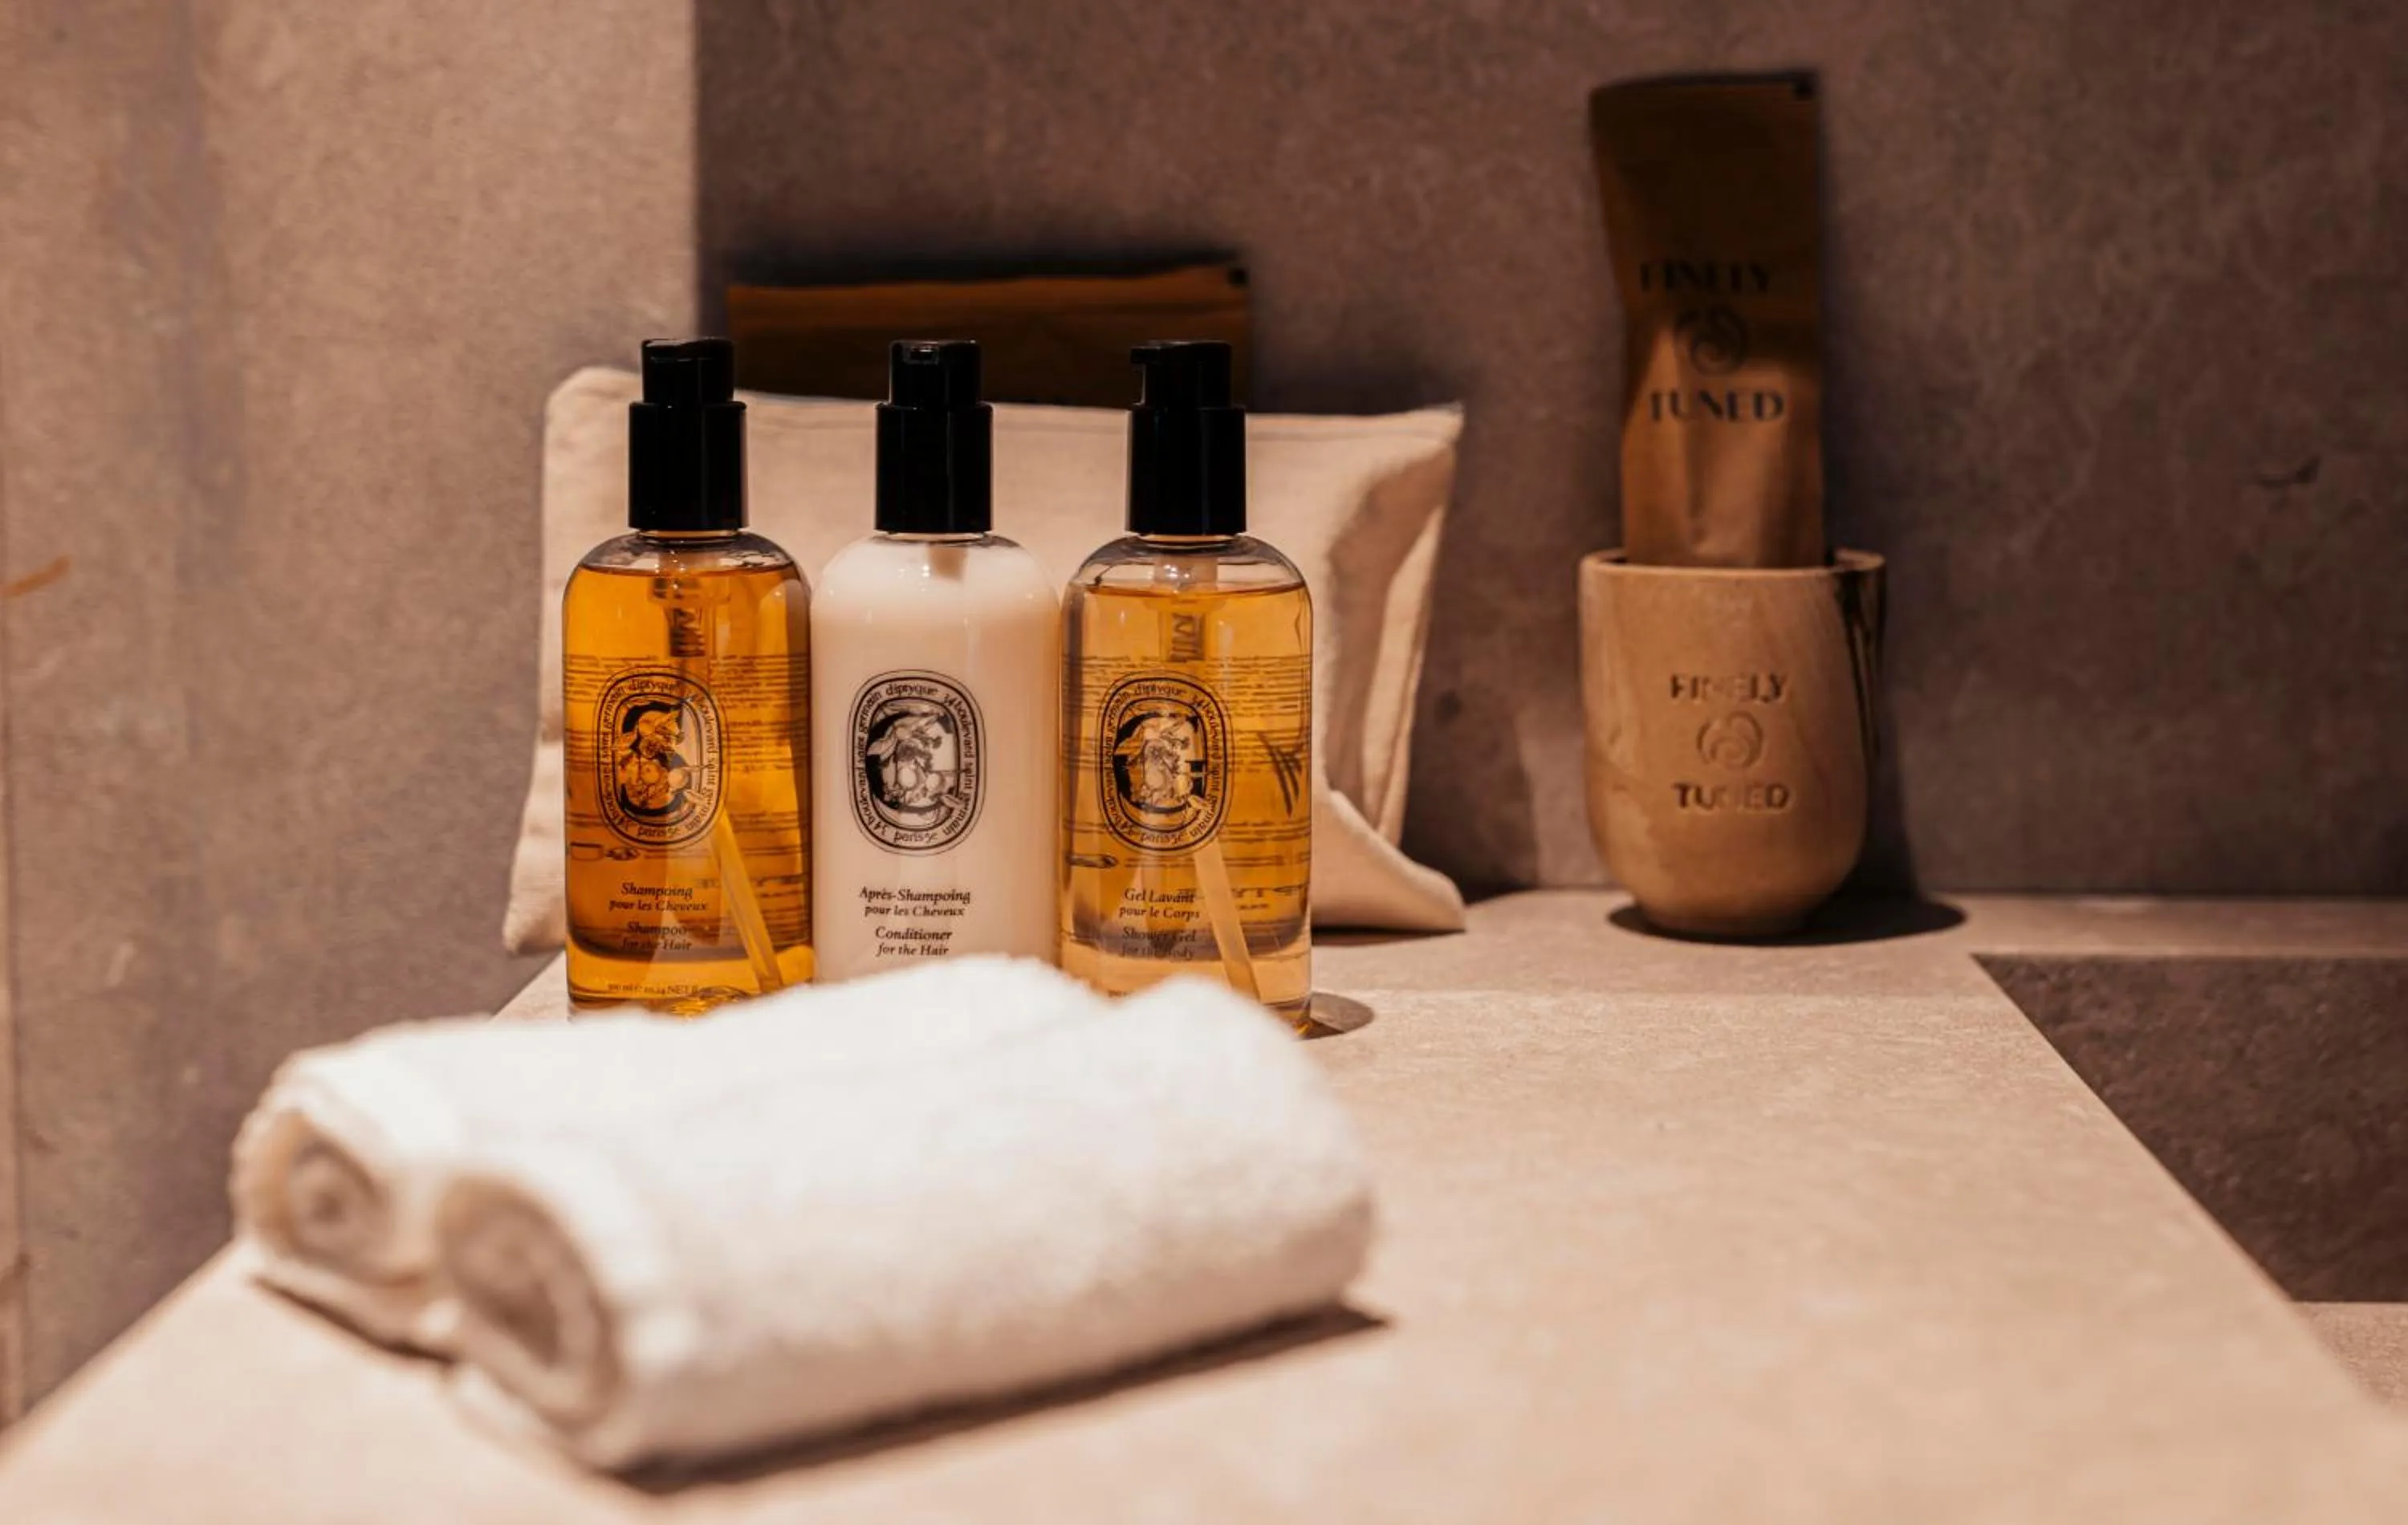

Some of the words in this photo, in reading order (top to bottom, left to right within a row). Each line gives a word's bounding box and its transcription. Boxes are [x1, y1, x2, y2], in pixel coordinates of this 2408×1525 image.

[1649, 389, 1785, 423] TUNED
[885, 683, 938, 696] diptyque
[1134, 683, 1186, 697] diptyque
[1670, 673, 1788, 702] FINELY
[964, 762, 974, 789] saint
[1672, 782, 1790, 811] TUNED
[620, 881, 694, 900] Shampoing
[859, 885, 970, 905] Après-Shampoing
[1124, 887, 1146, 901] Gel
[1149, 889, 1195, 904] Lavant
[608, 900, 635, 912] pour
[638, 899, 653, 911] les
[655, 901, 707, 912] Cheveux
[864, 906, 891, 917] pour
[894, 905, 909, 916] les
[913, 905, 965, 916] Cheveux
[1118, 907, 1147, 918] pour
[1150, 906, 1160, 918] le
[1163, 907, 1200, 922] Corps
[627, 921, 687, 938] Shampoo
[875, 925, 954, 941] Conditioner
[663, 939, 692, 951] Hair
[875, 941, 895, 957] for
[898, 943, 917, 955] the
[920, 944, 950, 956] Hair
